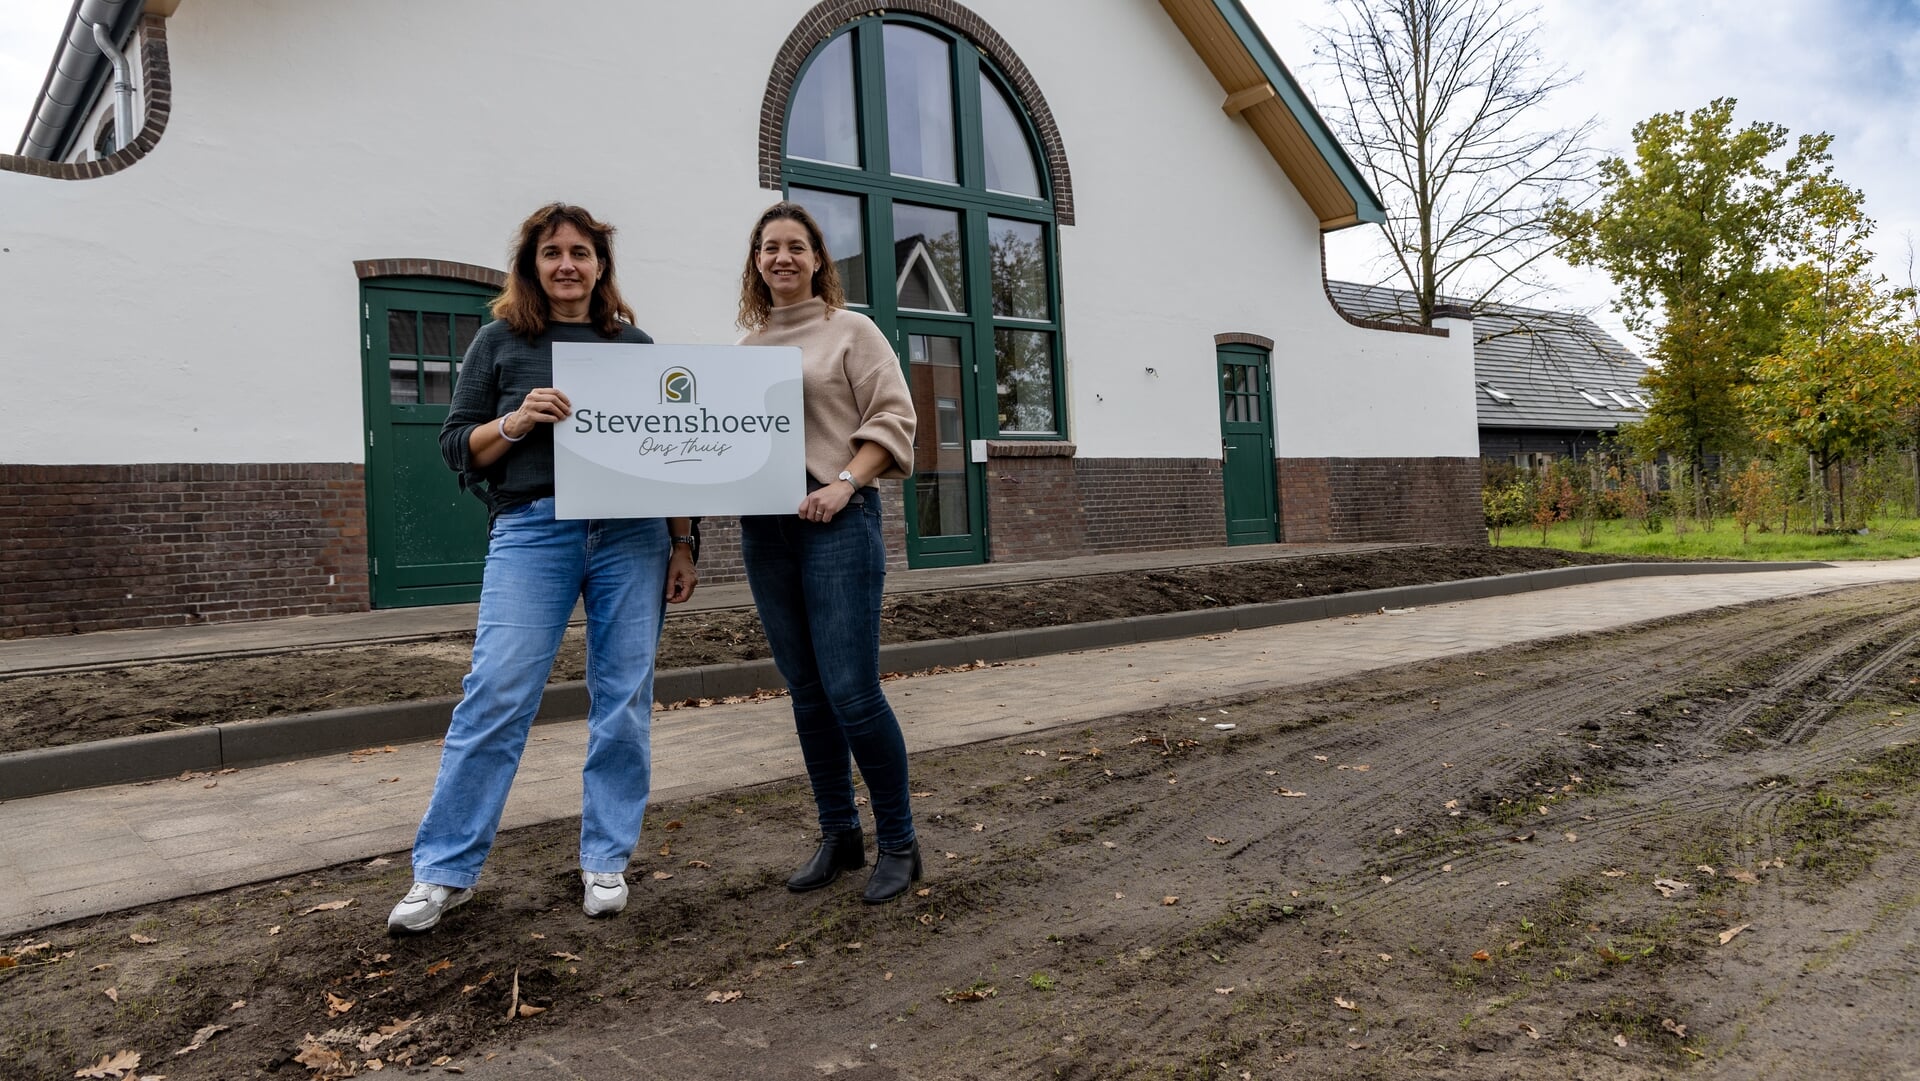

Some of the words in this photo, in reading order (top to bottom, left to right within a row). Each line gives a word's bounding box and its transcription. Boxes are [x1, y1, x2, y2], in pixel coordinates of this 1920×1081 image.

[574, 407, 791, 434] Stevenshoeve
[638, 436, 678, 457] Ons
[680, 437, 732, 457] thuis
